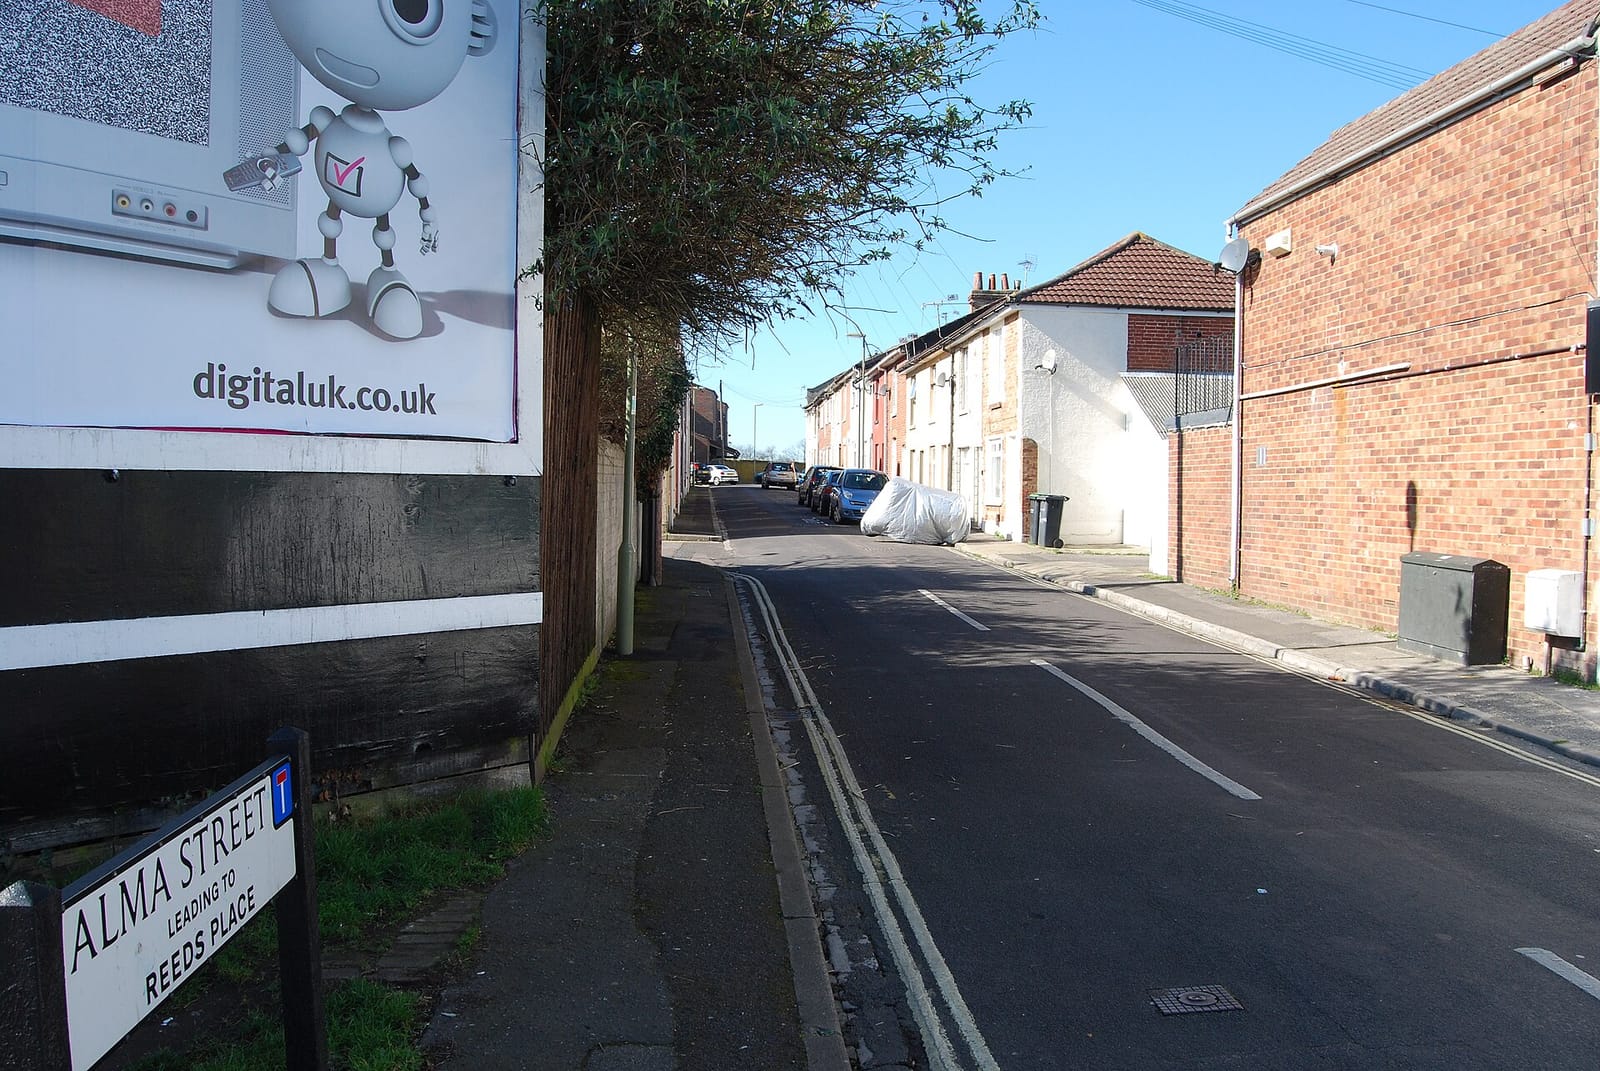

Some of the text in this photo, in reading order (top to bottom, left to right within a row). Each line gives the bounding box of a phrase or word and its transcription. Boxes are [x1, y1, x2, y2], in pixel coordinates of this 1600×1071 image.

[193, 361, 437, 415] digitaluk.co.uk
[71, 787, 266, 975] ALMA STREET
[167, 868, 236, 939] LEADING TO
[145, 884, 256, 1005] REEDS PLACE
